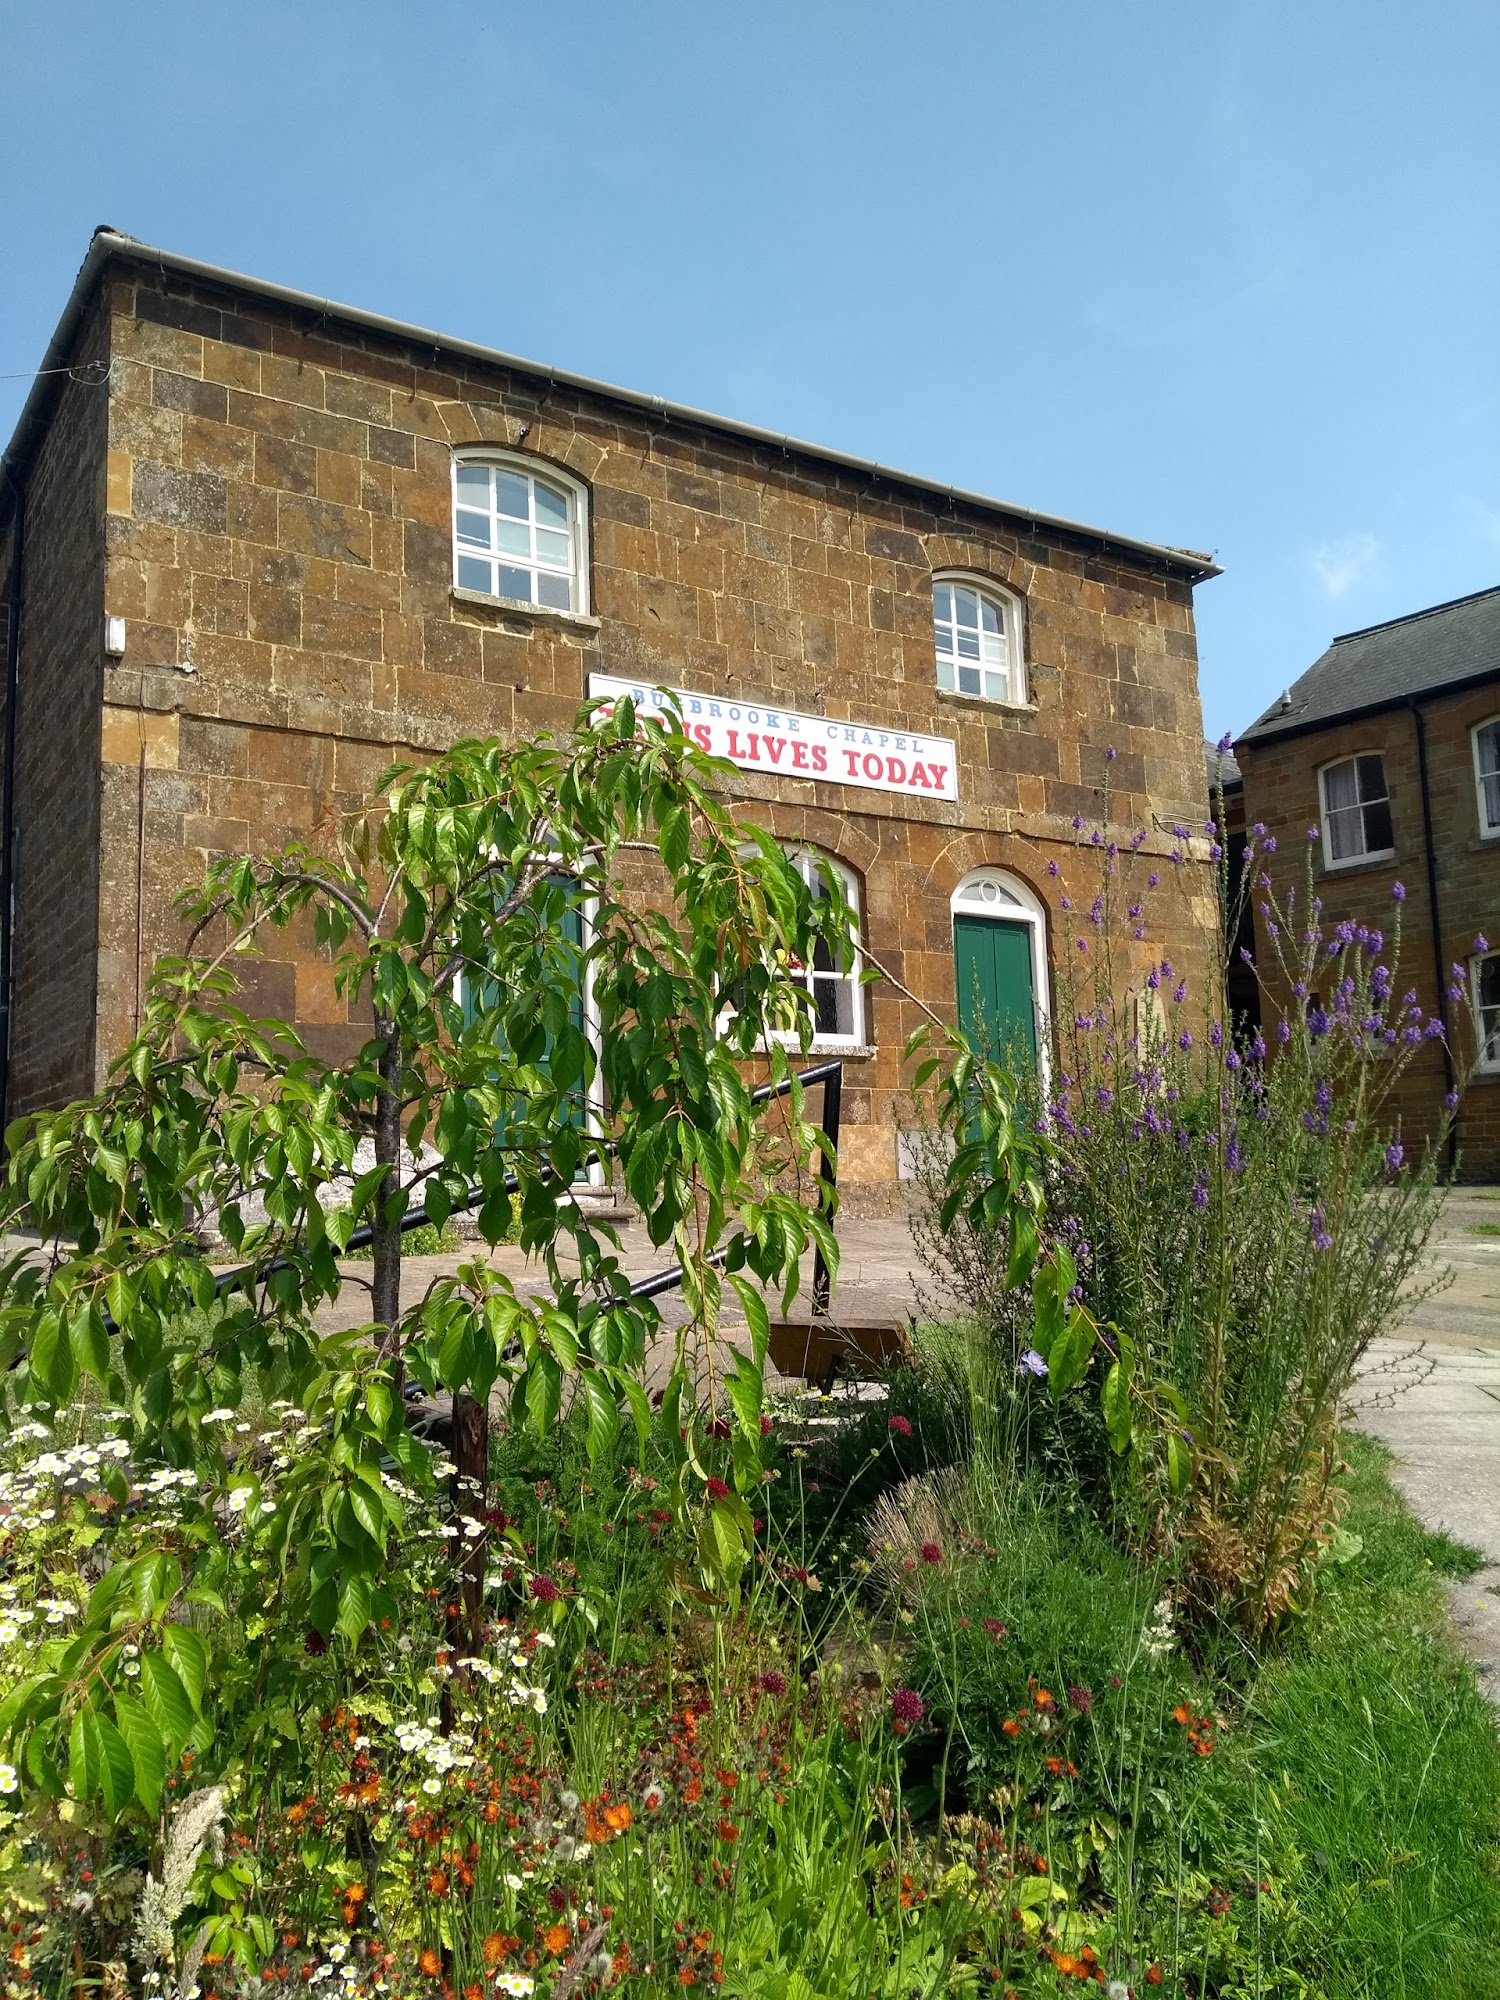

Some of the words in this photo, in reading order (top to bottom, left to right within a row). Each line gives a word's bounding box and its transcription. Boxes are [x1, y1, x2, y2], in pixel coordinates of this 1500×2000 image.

[726, 729, 828, 772] LIVES
[842, 749, 948, 791] TODAY
[826, 725, 925, 754] CHAPEL
